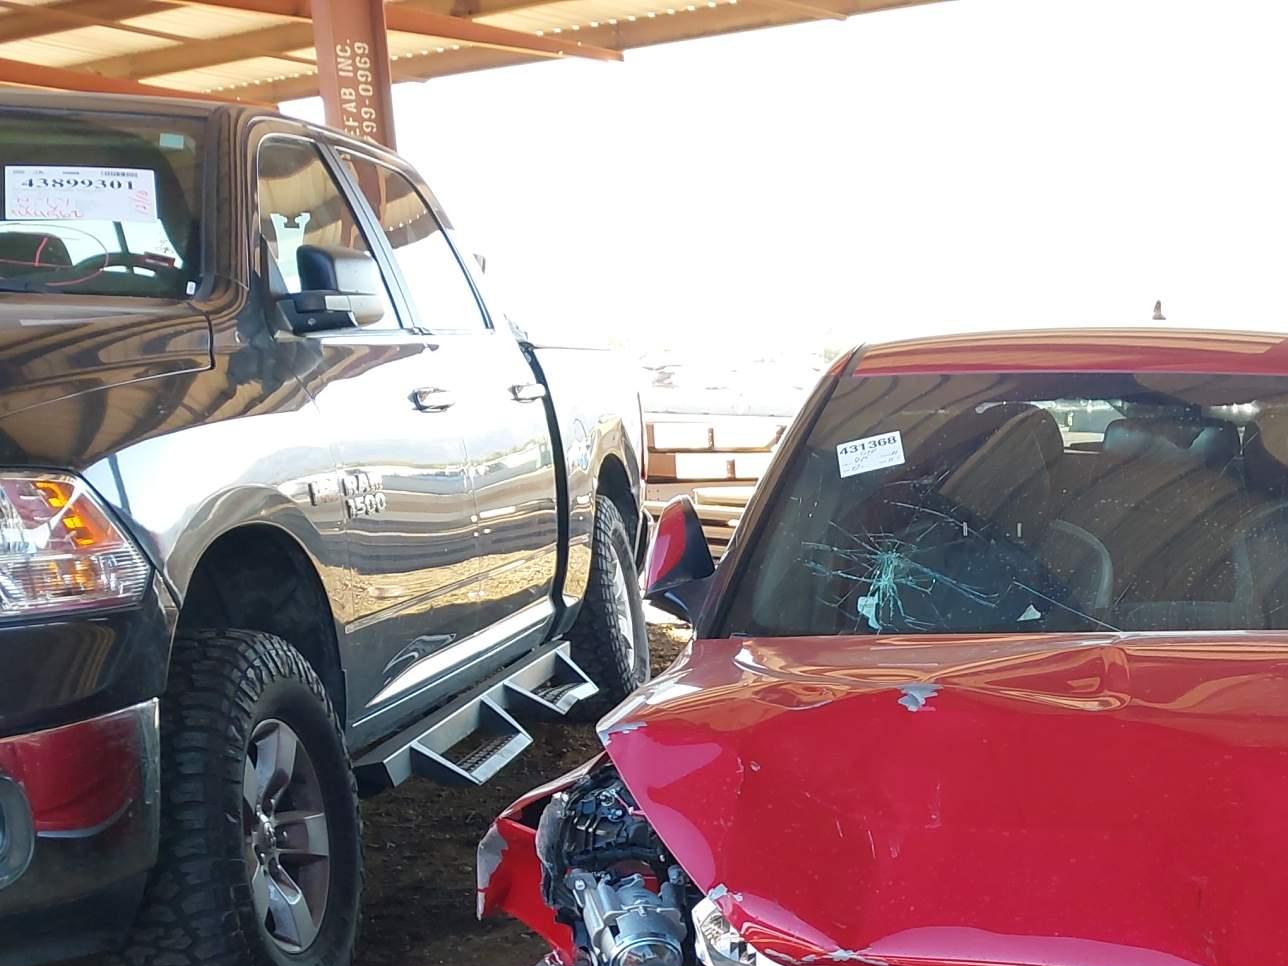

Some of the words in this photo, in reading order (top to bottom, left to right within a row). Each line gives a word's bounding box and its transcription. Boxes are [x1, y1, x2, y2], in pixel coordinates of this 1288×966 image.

[336, 39, 353, 77] INC.
[21, 178, 135, 191] 43899301
[840, 436, 897, 455] 431368
[345, 492, 386, 519] 1500
